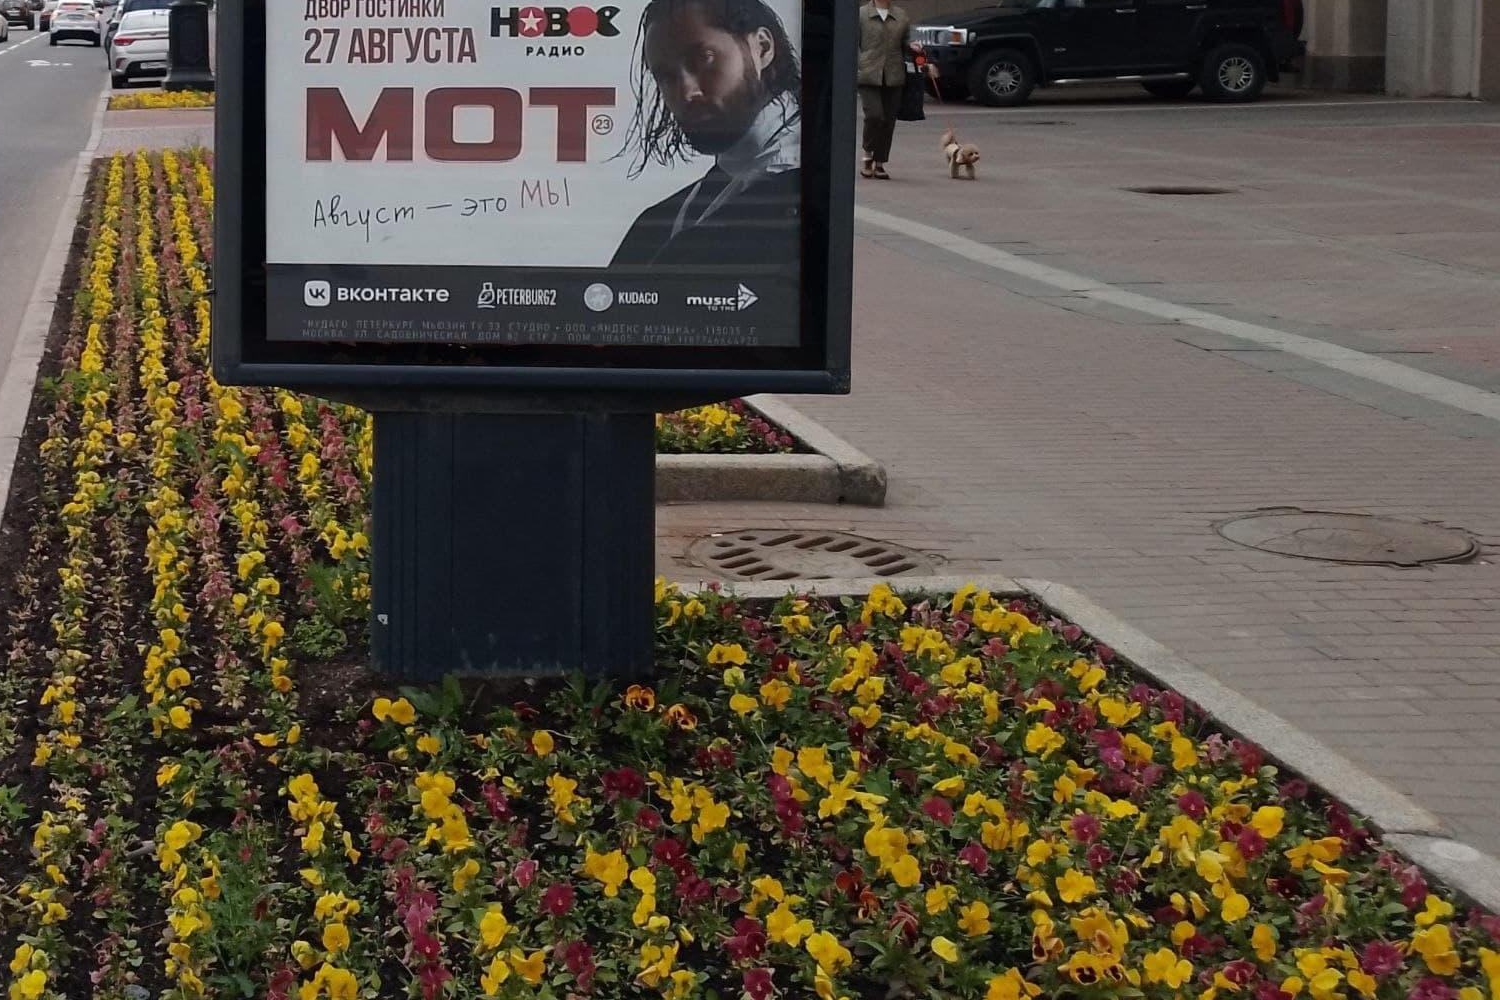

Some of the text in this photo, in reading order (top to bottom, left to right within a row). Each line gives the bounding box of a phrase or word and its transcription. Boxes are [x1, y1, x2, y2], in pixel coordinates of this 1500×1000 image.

[304, 27, 477, 65] 27 АВГУСТА
[525, 45, 585, 58] РАДИО
[305, 86, 616, 164] МОТ
[594, 118, 610, 131] 23
[312, 194, 415, 242] Август
[460, 196, 508, 217] это
[520, 178, 571, 209] МЫ
[337, 287, 449, 302] вконтакте
[496, 287, 557, 305] PETERBURG2
[618, 291, 659, 305] KUDAGO
